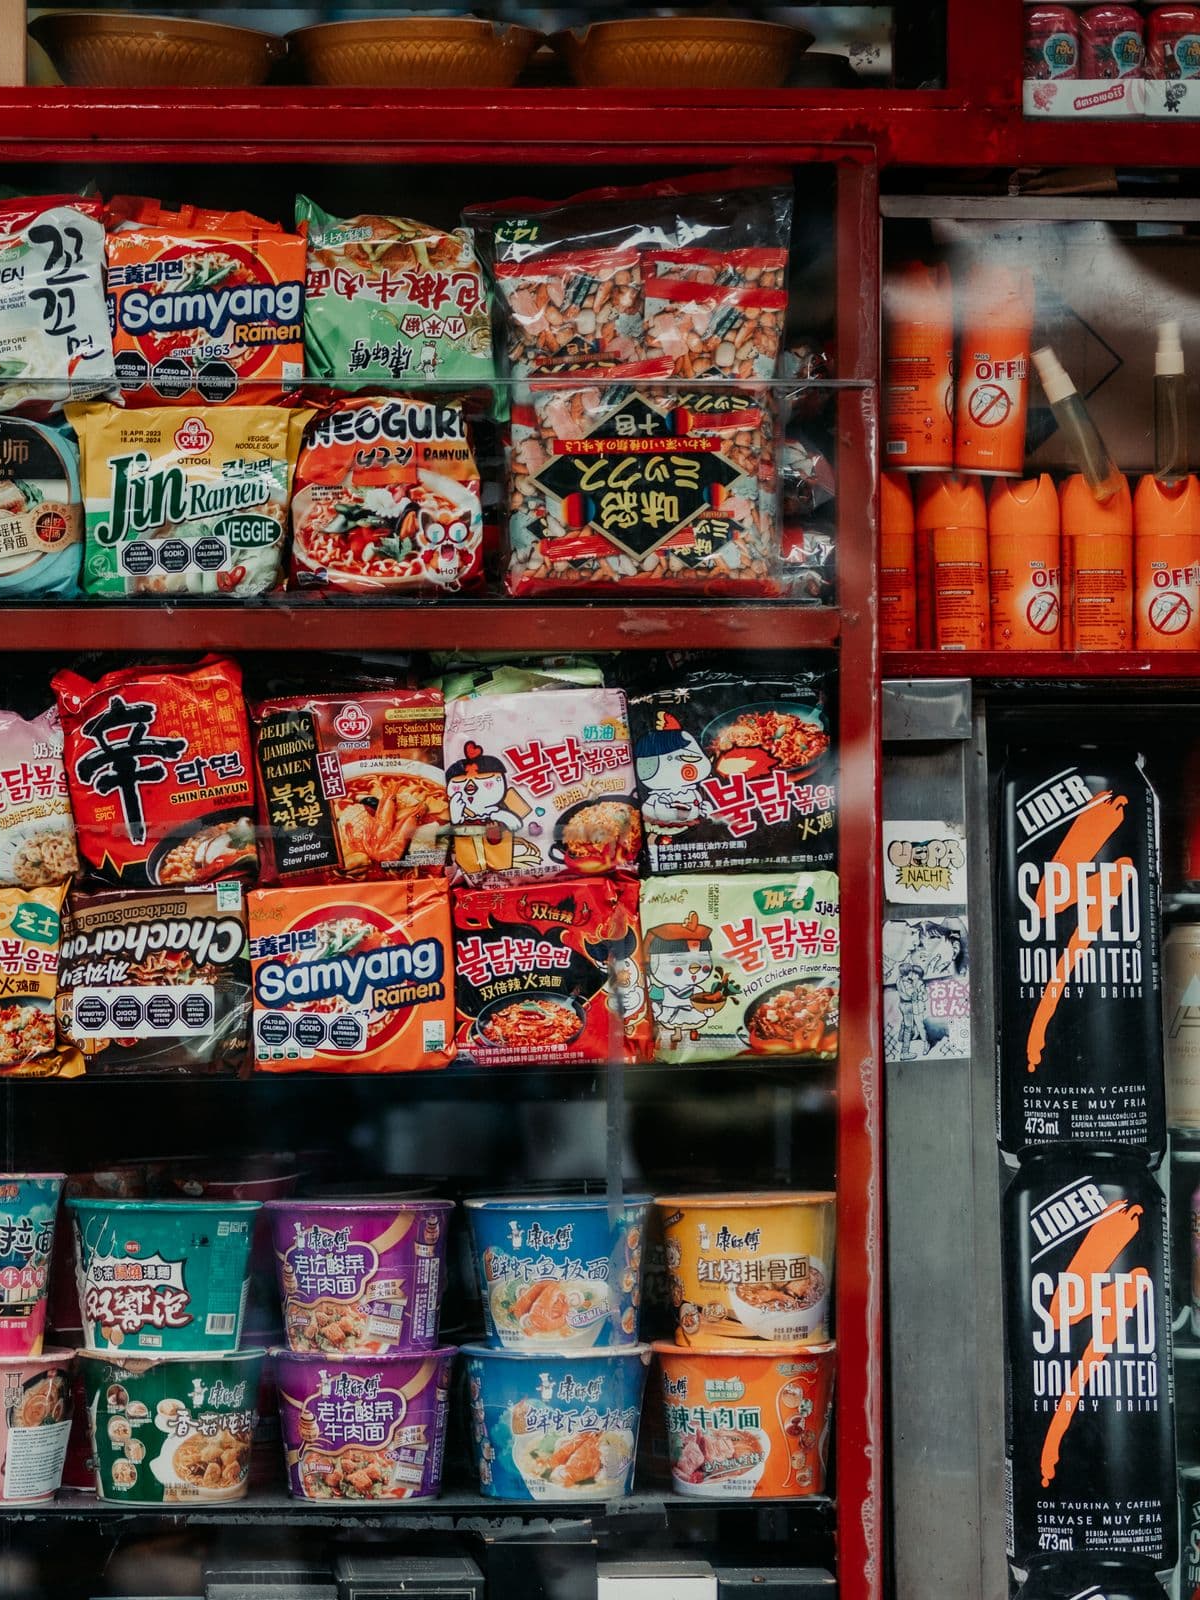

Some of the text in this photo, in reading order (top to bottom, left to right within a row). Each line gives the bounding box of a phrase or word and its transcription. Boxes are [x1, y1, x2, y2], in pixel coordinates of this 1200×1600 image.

[107, 259, 183, 287] 三養라면
[122, 281, 299, 334] Samyang
[235, 324, 300, 343] Ramen
[402, 316, 466, 337] 小米椒
[173, 343, 230, 358] SINCE 1963
[357, 447, 414, 467] 너구리
[423, 448, 469, 460] RAMYUN
[574, 456, 701, 491] ミックス
[97, 453, 187, 545] Jin
[190, 480, 266, 515] Ramen
[601, 491, 679, 529] 味彩
[223, 521, 275, 542] VEGGIE
[260, 718, 310, 741] BEIJING
[584, 725, 614, 742] 奶油
[76, 695, 188, 846] 辛
[174, 751, 244, 786] 라면
[265, 758, 312, 780] RAMEN
[320, 755, 343, 795] 北京
[504, 737, 631, 797] 불닭볶음면
[170, 782, 248, 805] SHIN RAMYUN
[553, 778, 625, 809] 奶油火鸡面
[95, 811, 116, 822] SPICY
[1017, 774, 1094, 837] LIDER
[288, 841, 321, 854] Seafood
[291, 832, 314, 843] Spicy
[283, 851, 329, 866] Stew Flavor
[86, 902, 186, 925] Blackbean Sauce
[531, 903, 573, 924] 双倍辣
[1017, 862, 1140, 943] SPEED
[17, 909, 58, 937] 芝士
[259, 942, 436, 1001] Samyang
[1019, 947, 1142, 984] UNLIMITED
[374, 983, 440, 1008] Ramen
[480, 972, 562, 1001] 双倍辣火鸡面
[1020, 987, 1084, 999] ENERGY
[1112, 1085, 1146, 1093] CAFEINA
[1024, 1098, 1146, 1109] SIRVASE MUY FRIA
[1025, 1118, 1059, 1135] 473ml
[1030, 1183, 1108, 1246] LIDER
[294, 1254, 364, 1276] 老坛酸菜
[697, 1257, 809, 1285] 红烧排骨面
[300, 1275, 357, 1295] 牛肉面
[1032, 1272, 1156, 1355] SPEED
[1033, 1358, 1158, 1397] UNLIMITED
[317, 1400, 394, 1422] 老坛酸菜
[1034, 1399, 1099, 1412] ENERGY
[323, 1423, 386, 1442] 牛肉面
[1037, 1501, 1055, 1509] CON
[1061, 1502, 1110, 1510] TAURINA
[1126, 1500, 1161, 1509] CAFEINA
[1037, 1514, 1162, 1525] SIRVASE MUY FRIA
[1038, 1533, 1073, 1551] 473ml
